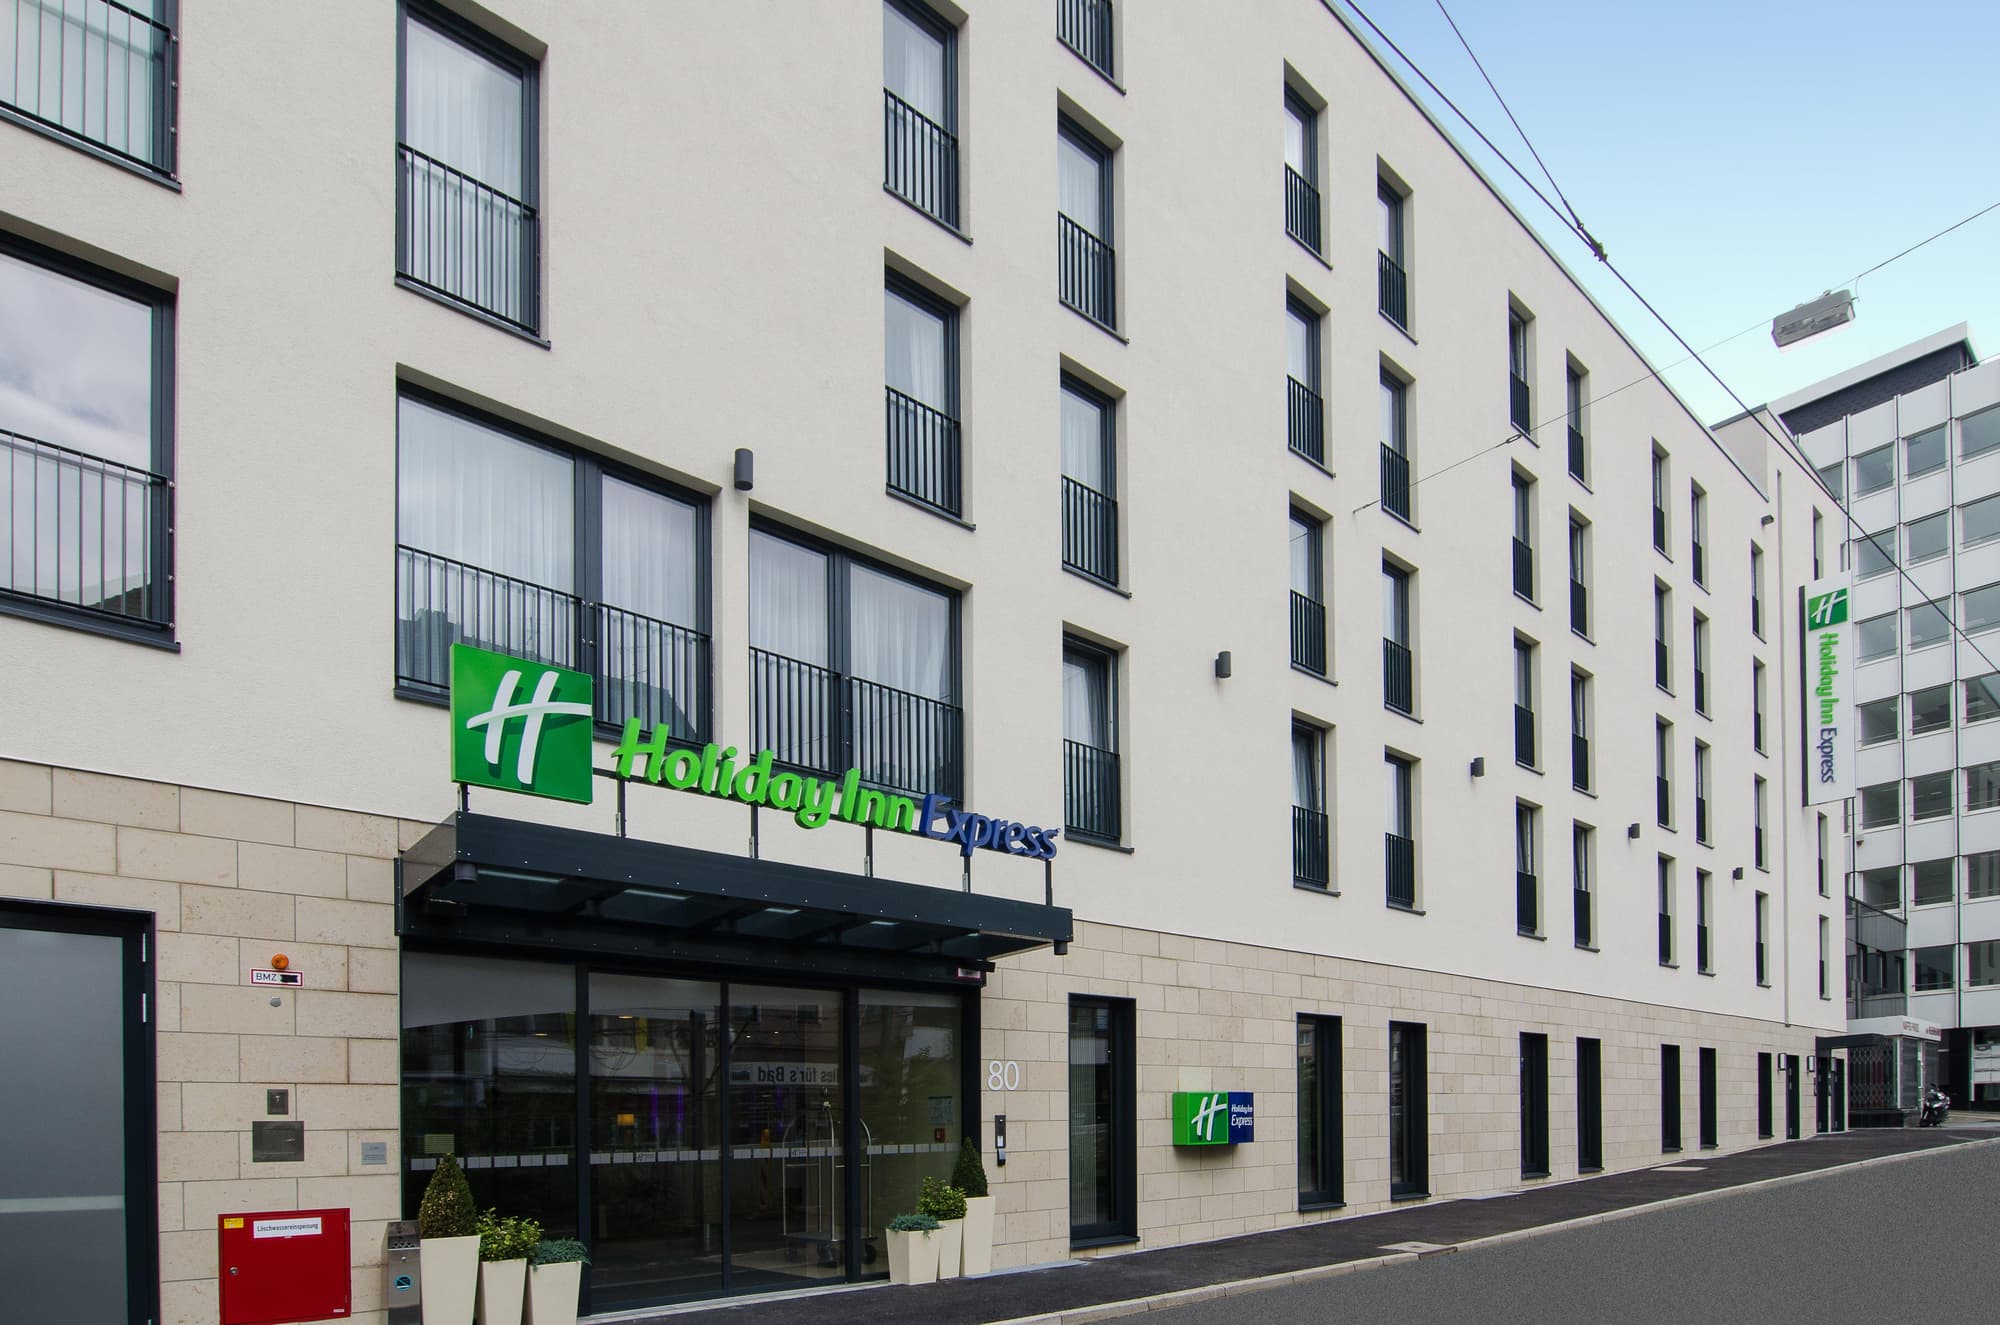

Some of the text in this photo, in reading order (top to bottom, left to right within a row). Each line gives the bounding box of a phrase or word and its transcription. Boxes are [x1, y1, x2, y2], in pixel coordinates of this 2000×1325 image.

[1815, 632, 1840, 784] Holiday Inn Express
[611, 717, 1062, 858] Holiday Inn Express
[255, 972, 277, 982] BMZ
[988, 1060, 1020, 1091] 80
[1231, 1114, 1252, 1128] Express
